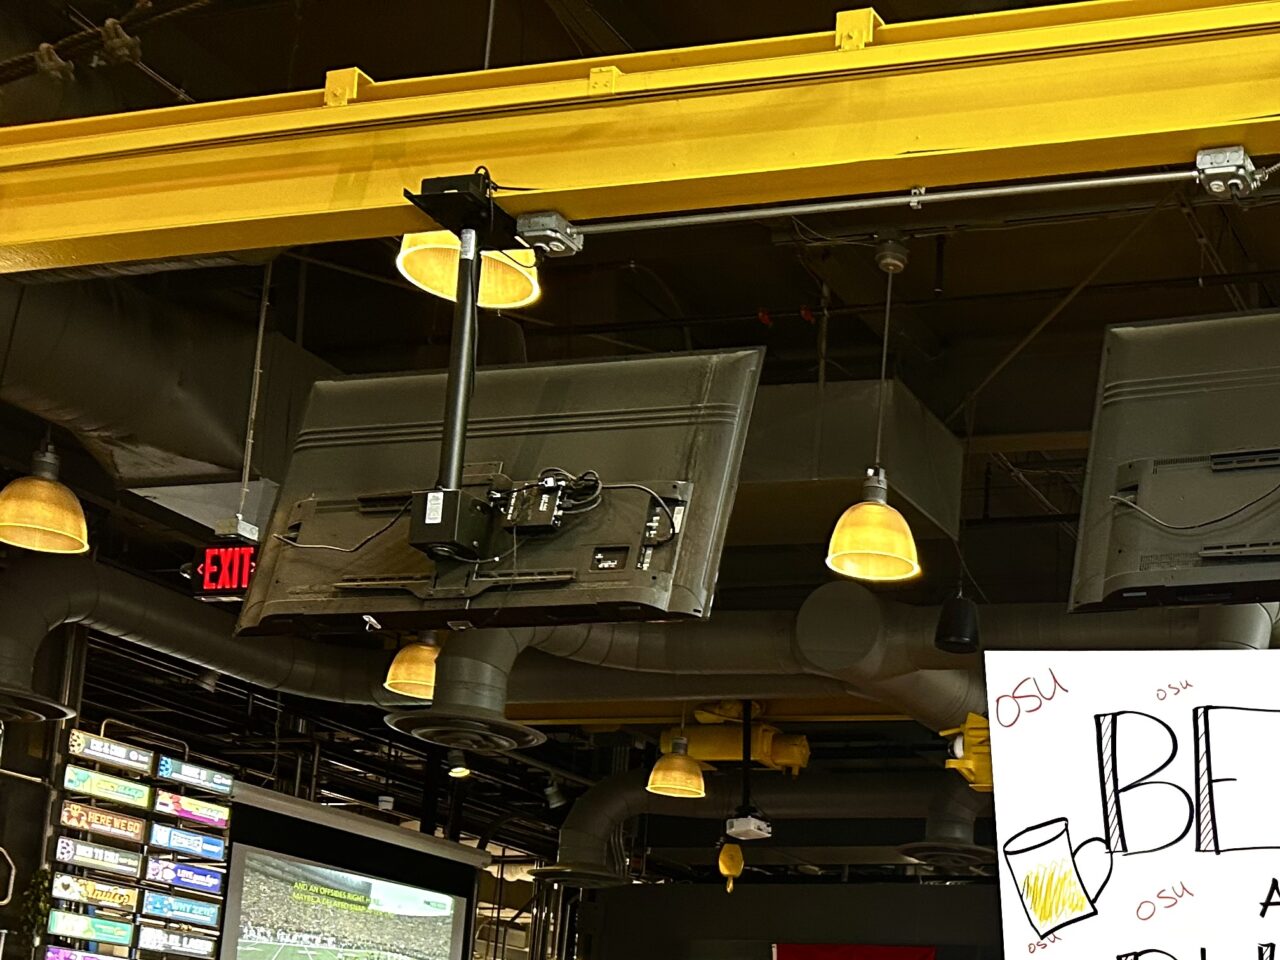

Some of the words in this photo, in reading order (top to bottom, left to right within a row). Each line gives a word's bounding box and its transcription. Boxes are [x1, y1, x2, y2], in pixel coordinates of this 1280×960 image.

[203, 547, 254, 590] EXIT
[996, 668, 1069, 728] OSU
[1157, 679, 1194, 701] OSU
[1137, 882, 1194, 921] OSU
